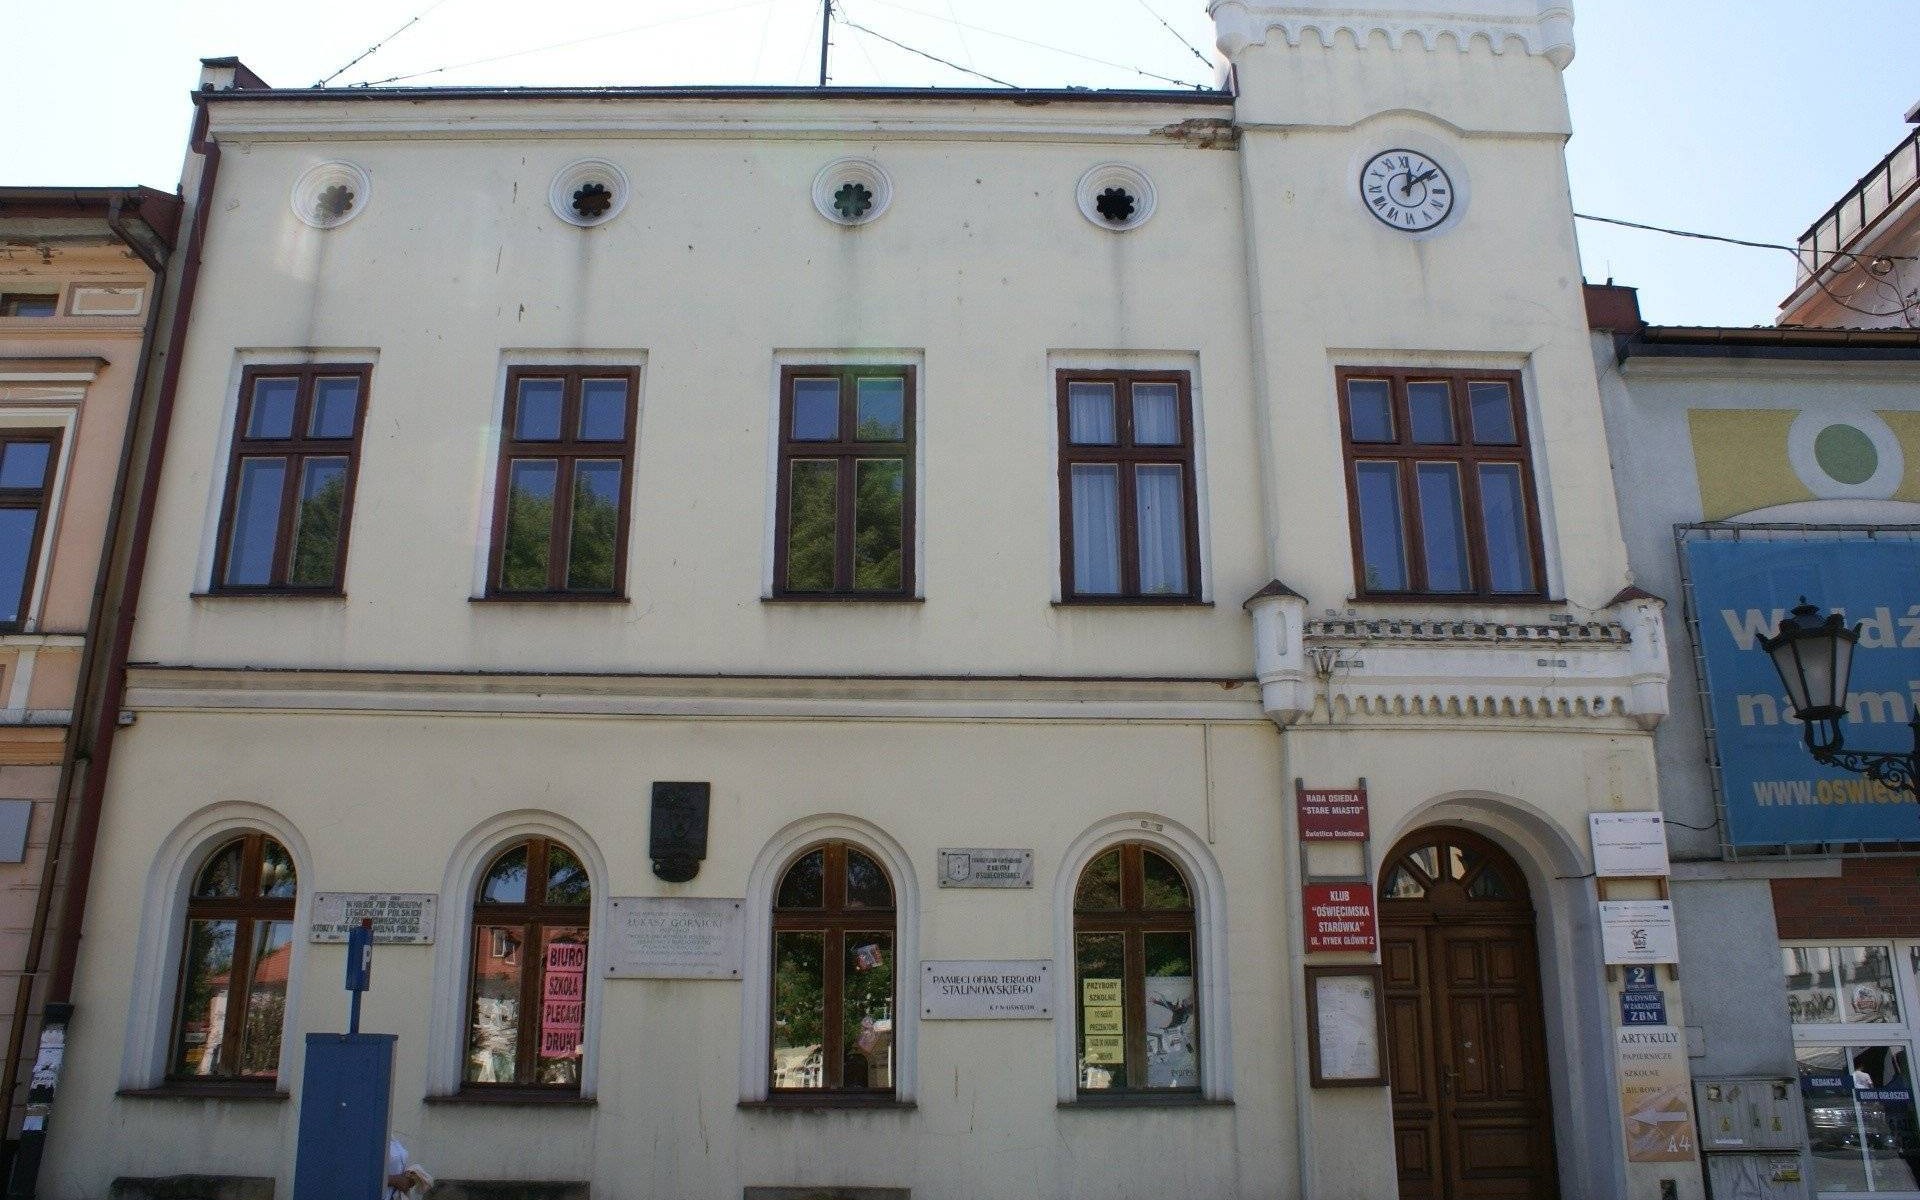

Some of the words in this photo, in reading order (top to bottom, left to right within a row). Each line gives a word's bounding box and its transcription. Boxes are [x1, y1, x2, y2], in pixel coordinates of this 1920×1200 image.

[1306, 794, 1326, 802] RADA
[1328, 794, 1359, 803] OSIEDLA
[1329, 890, 1350, 901] KLUB
[1322, 936, 1342, 945] RYNEK
[1343, 935, 1368, 945] GŁÓWNY
[1369, 936, 1375, 945] 2
[550, 947, 583, 967] BIURO
[1001, 975, 1041, 984] TERRORU
[1632, 967, 1646, 983] 2
[942, 985, 1033, 995] STALINOWSKIEGO
[1086, 982, 1118, 990] PRZYBORY
[1625, 994, 1658, 1002] BUDYNEK
[546, 1004, 580, 1024] PLECAKI
[1630, 1011, 1658, 1021] ZBM
[545, 1032, 577, 1051] DRUKI
[1621, 1032, 1679, 1044] ARTYKUŁY
[1622, 1052, 1673, 1061] PAPIERNICZE
[1624, 1069, 1661, 1077] SZKOLNE
[1811, 1078, 1843, 1087] REDAKCJA
[1625, 1086, 1662, 1094] BIUROWE
[1859, 1091, 1878, 1100] BIURO
[1666, 1134, 1693, 1154] A4
